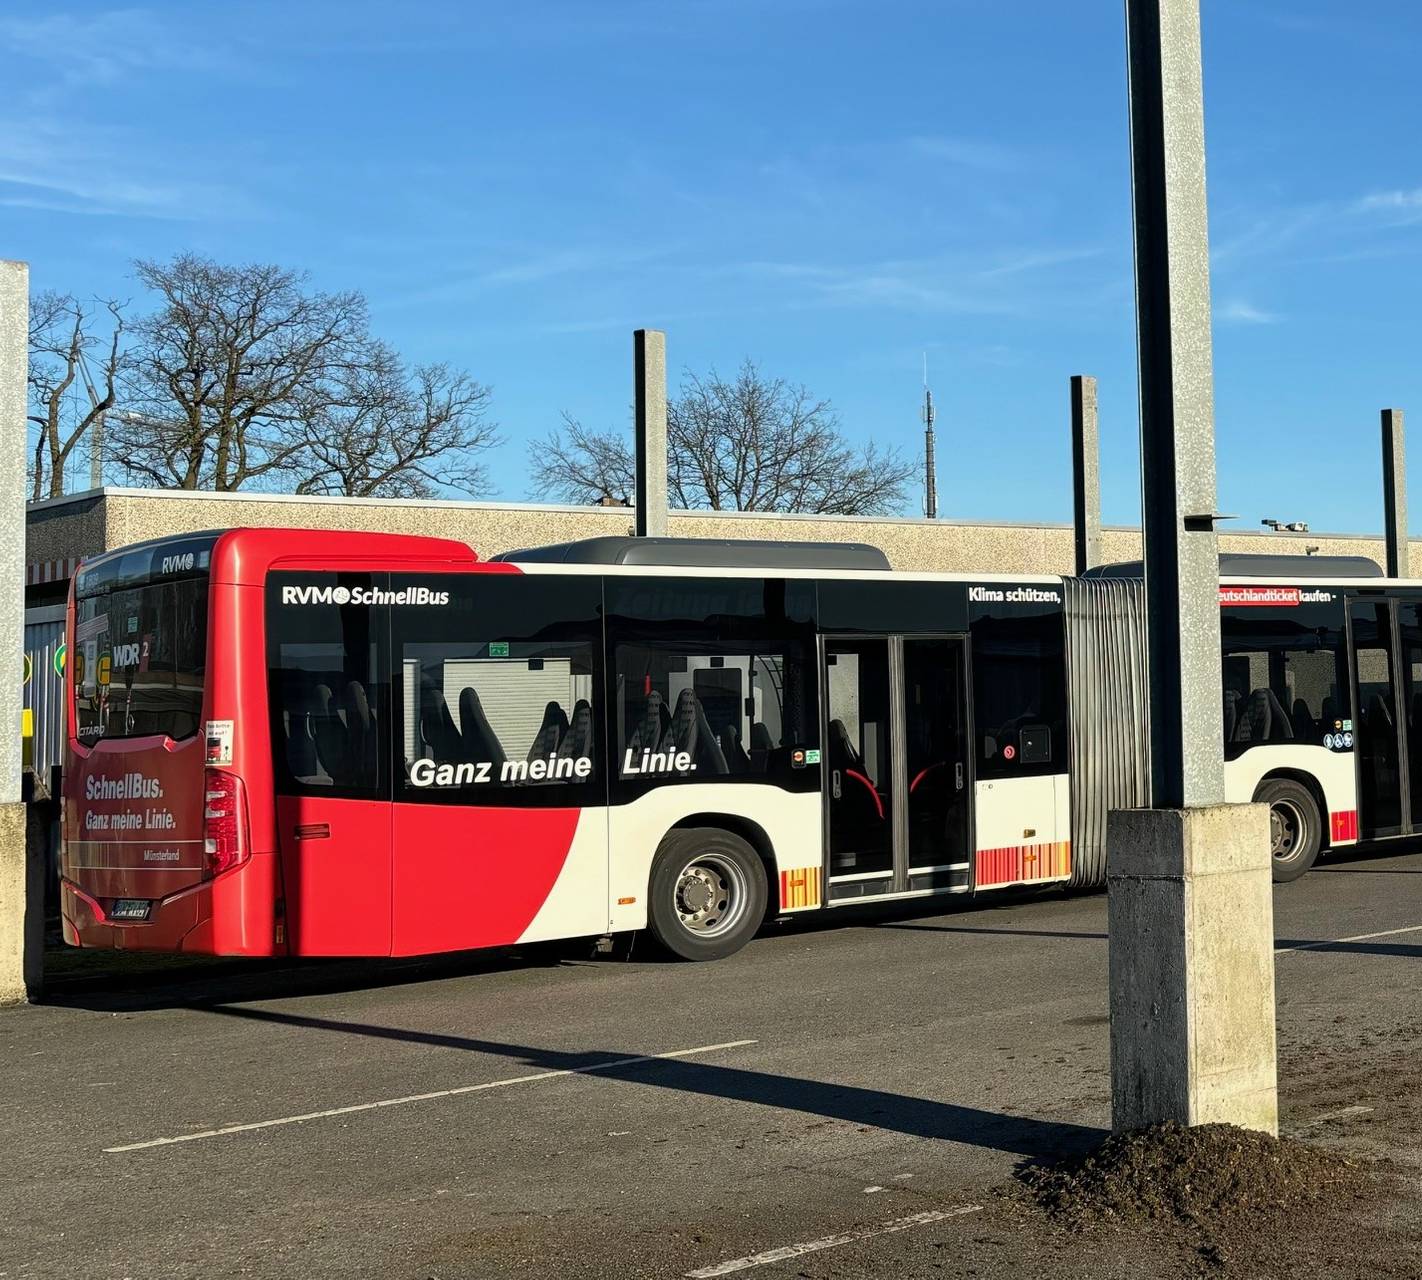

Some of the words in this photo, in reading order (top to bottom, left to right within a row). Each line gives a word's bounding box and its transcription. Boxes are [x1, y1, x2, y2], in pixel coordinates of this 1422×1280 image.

[162, 554, 186, 574] RVM
[282, 586, 332, 605] RVM
[350, 586, 449, 605] SchnellBus
[968, 587, 1004, 601] Klima
[1005, 587, 1061, 604] schützen,
[1219, 589, 1298, 602] eutschlandticket
[1299, 589, 1331, 602] kaufen
[114, 643, 140, 668] WDR
[410, 758, 491, 786] Ganz
[500, 752, 592, 782] meine
[622, 746, 697, 775] Linie.
[86, 773, 164, 800] SchnellBus.
[86, 809, 109, 830] Ganz
[111, 808, 143, 830] meine
[145, 807, 177, 829] Linie.
[143, 848, 180, 861] Münsterland
